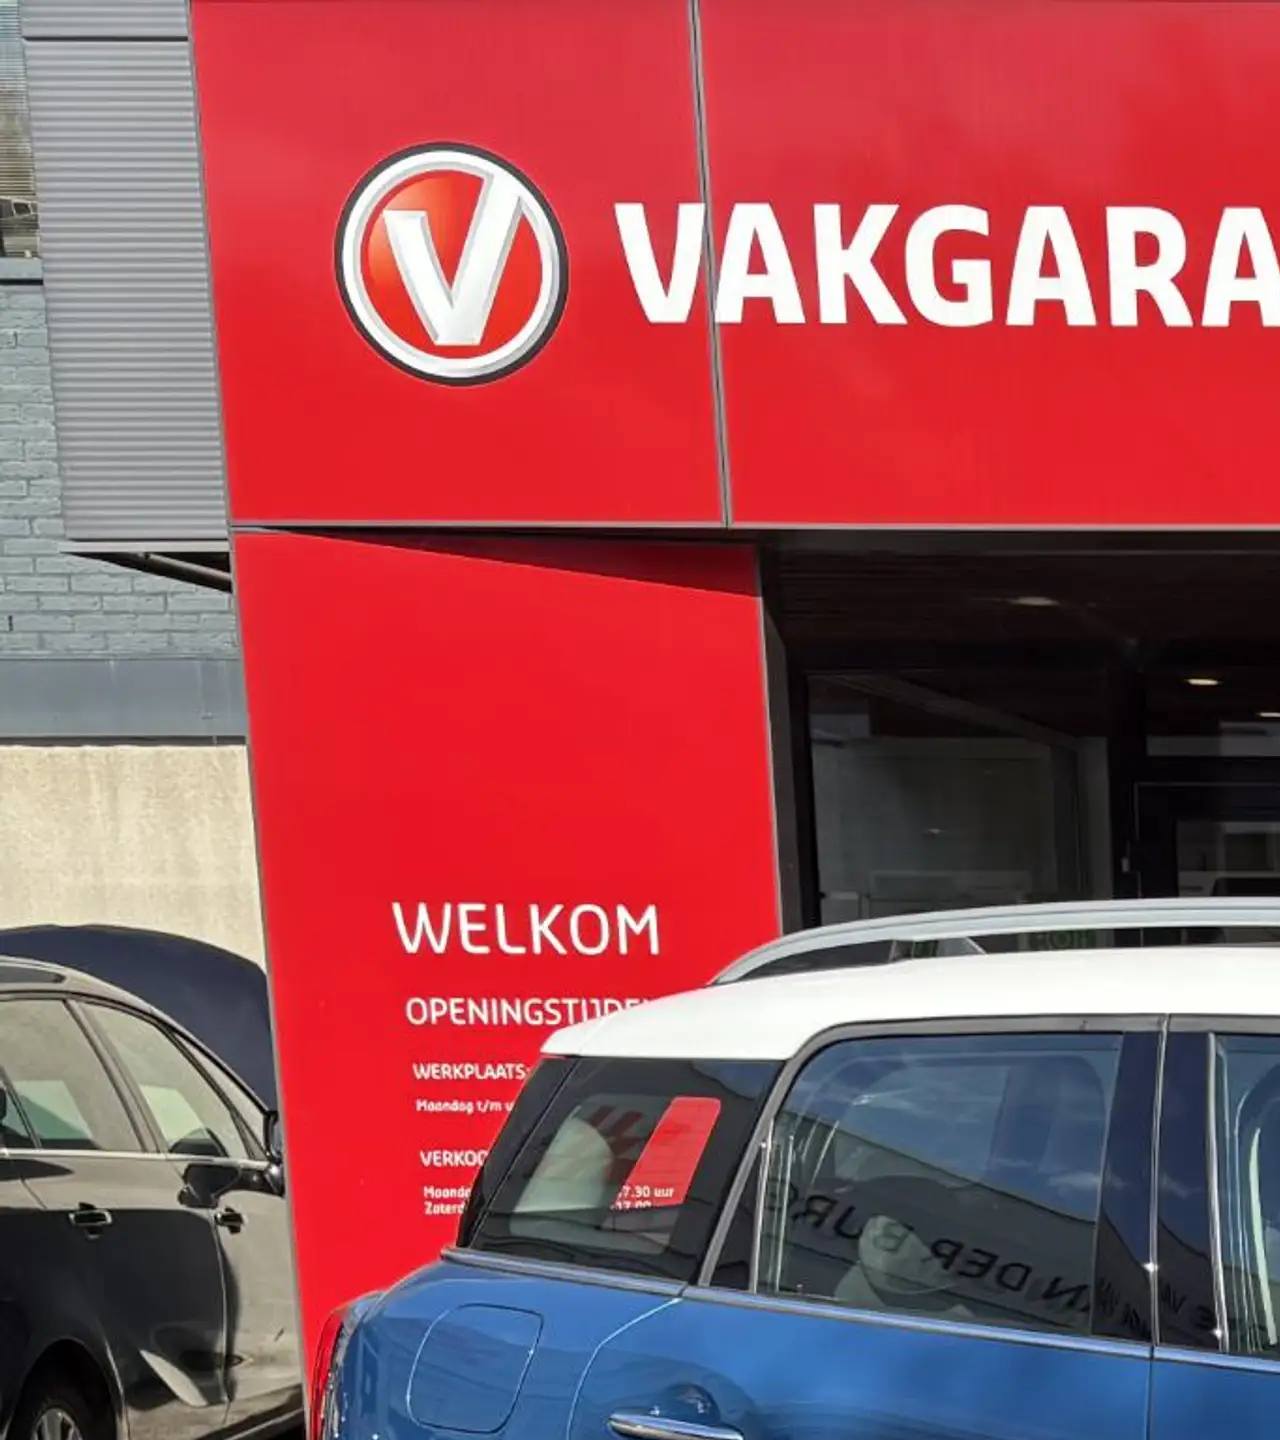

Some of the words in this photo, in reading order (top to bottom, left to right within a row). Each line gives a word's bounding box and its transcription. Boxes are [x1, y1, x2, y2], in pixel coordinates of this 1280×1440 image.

[392, 901, 659, 956] WELKOM
[416, 1100, 474, 1114] Maandag
[477, 1100, 502, 1113] t/m
[653, 1187, 674, 1198] uur
